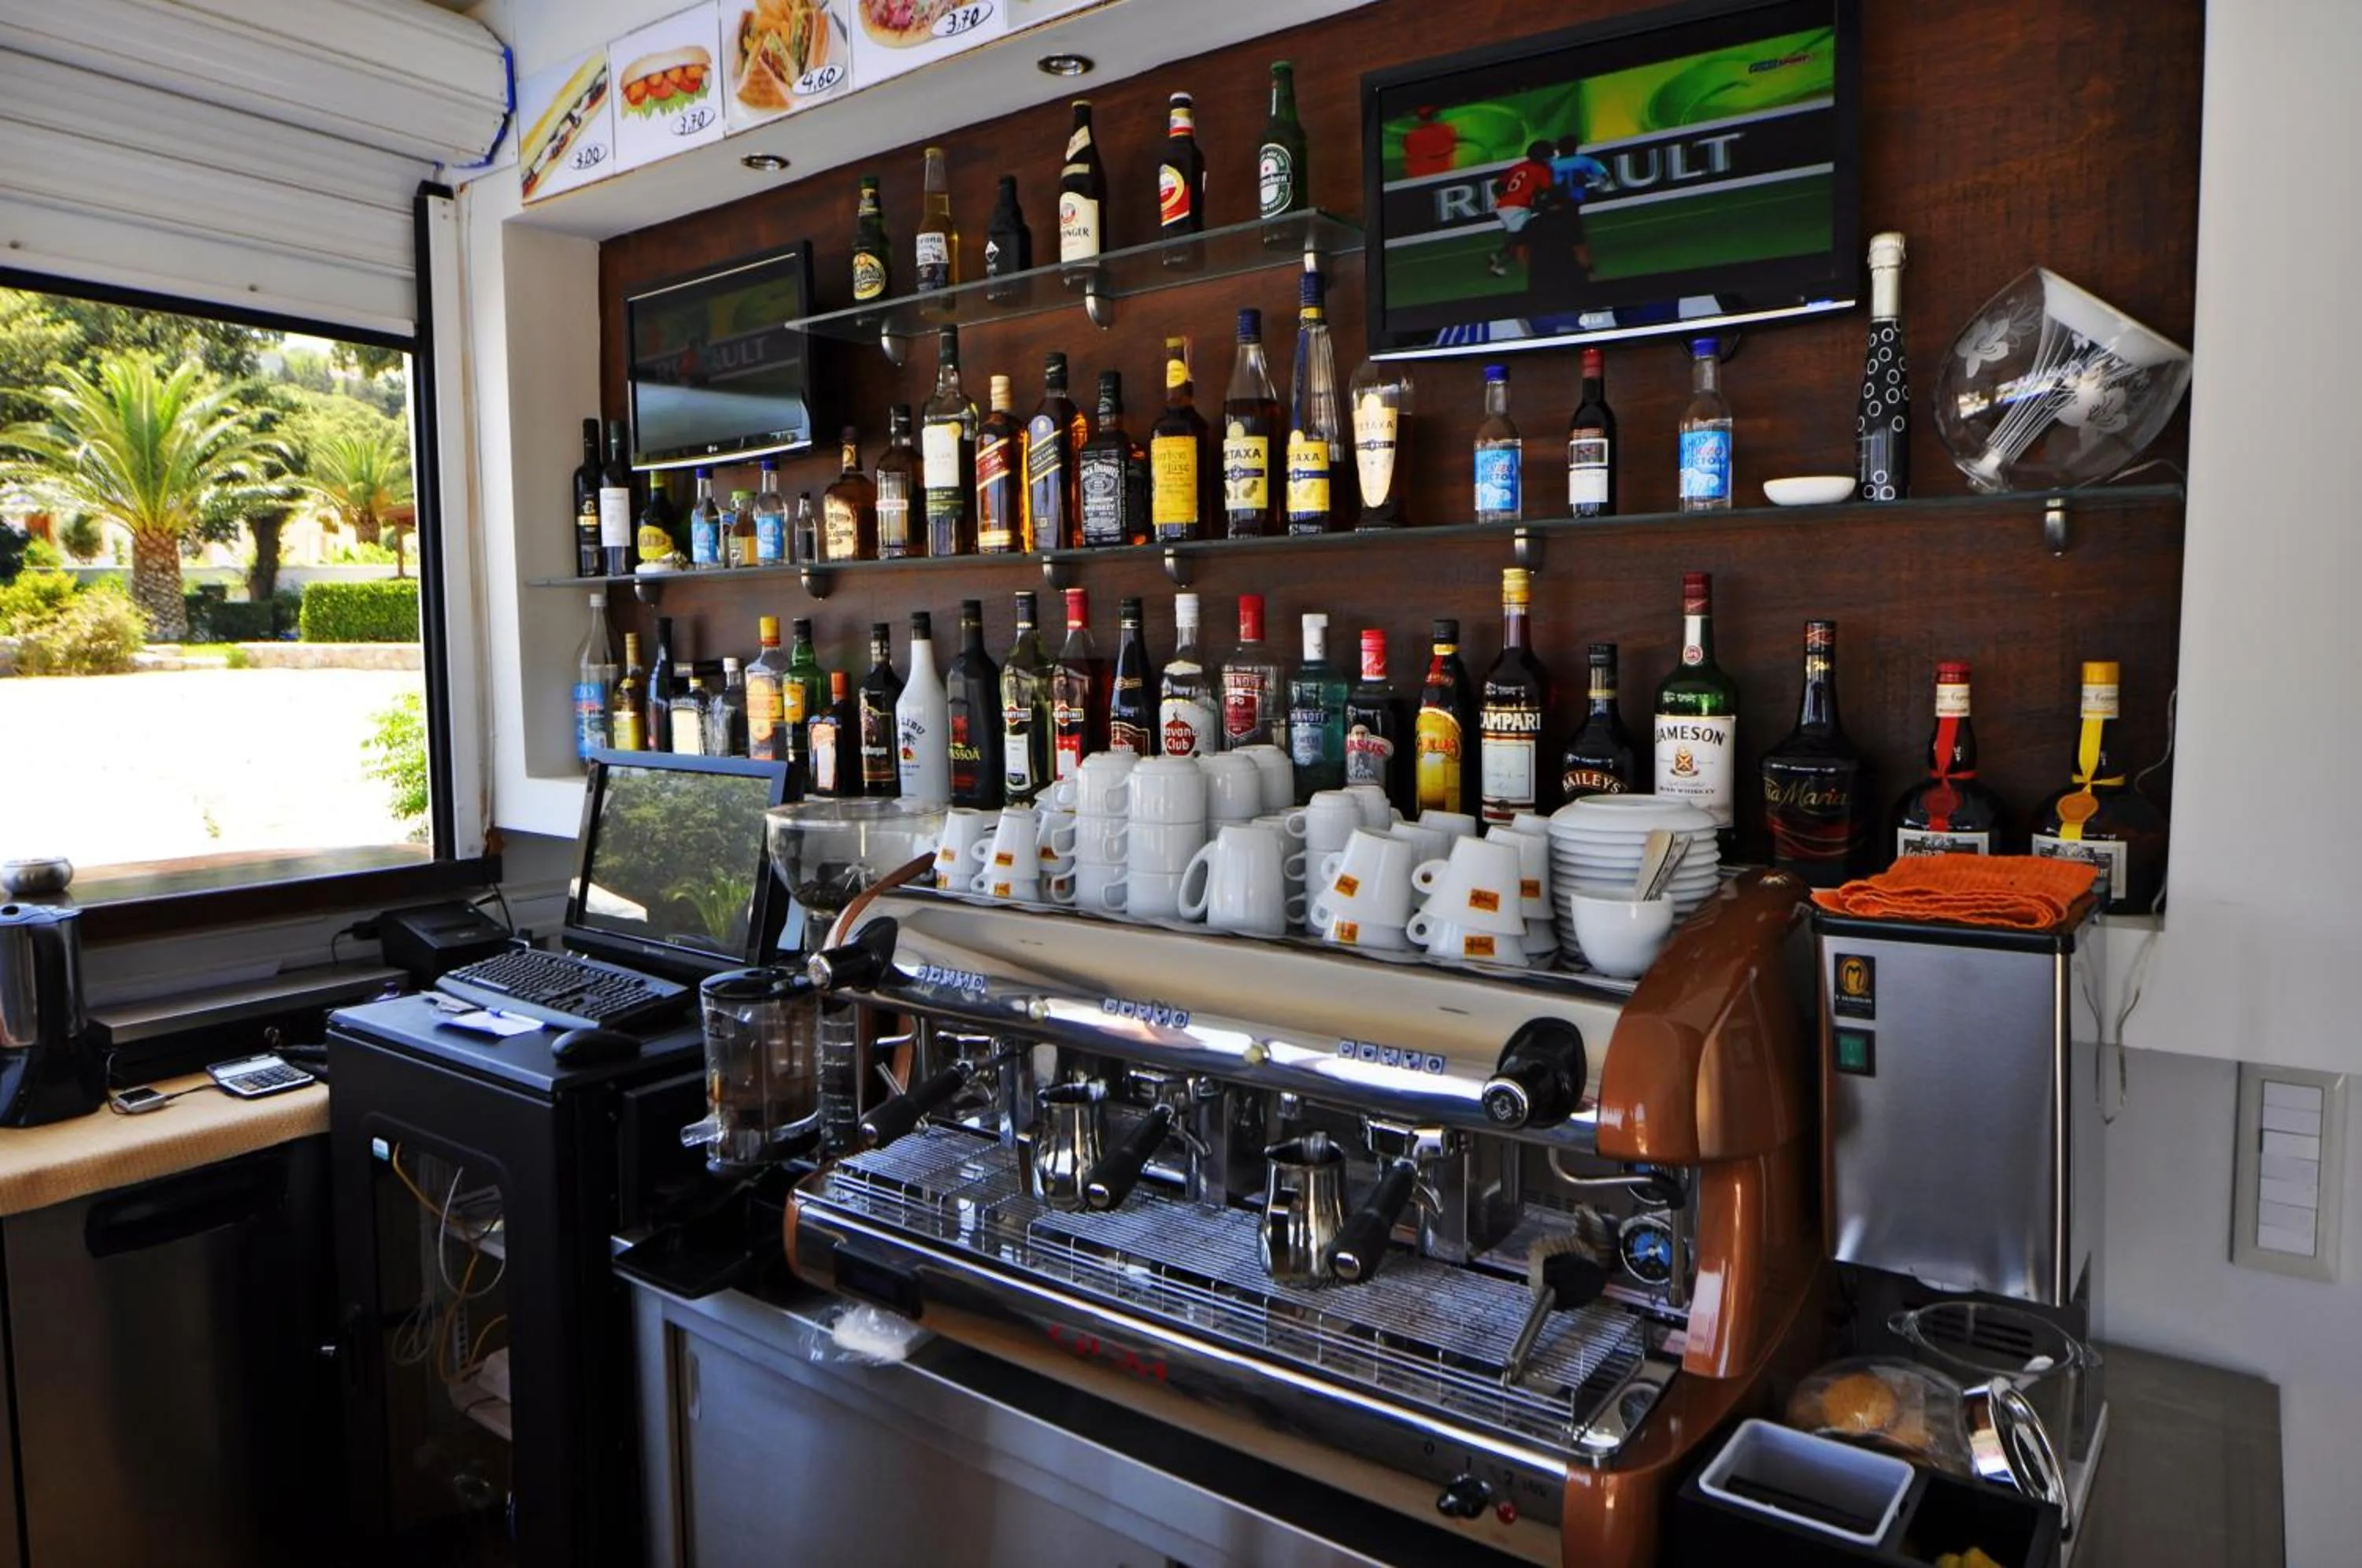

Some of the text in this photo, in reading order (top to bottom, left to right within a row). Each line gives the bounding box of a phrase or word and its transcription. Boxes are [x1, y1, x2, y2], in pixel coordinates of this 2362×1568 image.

[1436, 133, 1742, 221] RULT
[1224, 447, 1262, 460] ETAXA
[1167, 738, 1190, 751] Club
[1656, 725, 1726, 746] JAMESON
[1562, 772, 1622, 794] BAILEYS
